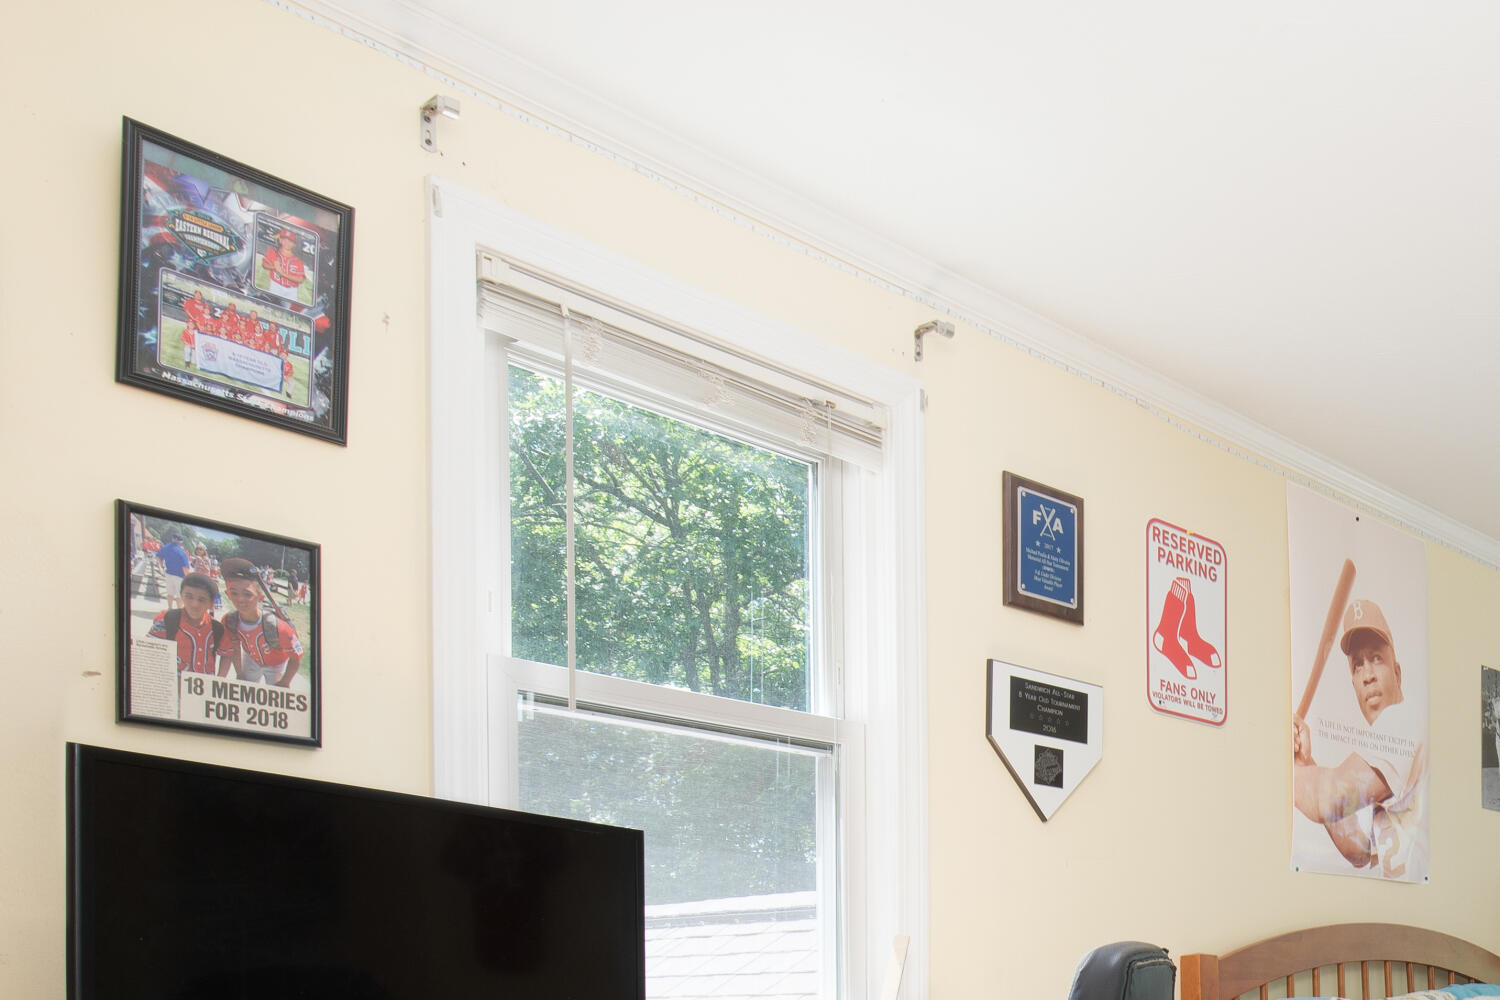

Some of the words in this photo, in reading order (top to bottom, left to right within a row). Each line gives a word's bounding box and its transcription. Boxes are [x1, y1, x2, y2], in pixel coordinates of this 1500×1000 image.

[1152, 525, 1222, 565] RESERVED
[1157, 546, 1218, 582] PARKING
[184, 677, 205, 696] 18
[211, 680, 308, 712] MEMORIES
[1152, 691, 1182, 705] VIOLATORS
[1183, 698, 1196, 708] WILL
[1197, 702, 1203, 710] BE
[1160, 679, 1187, 697] FANS
[1190, 688, 1216, 705] ONLY
[205, 700, 240, 723] FOR
[246, 707, 288, 730] 2018
